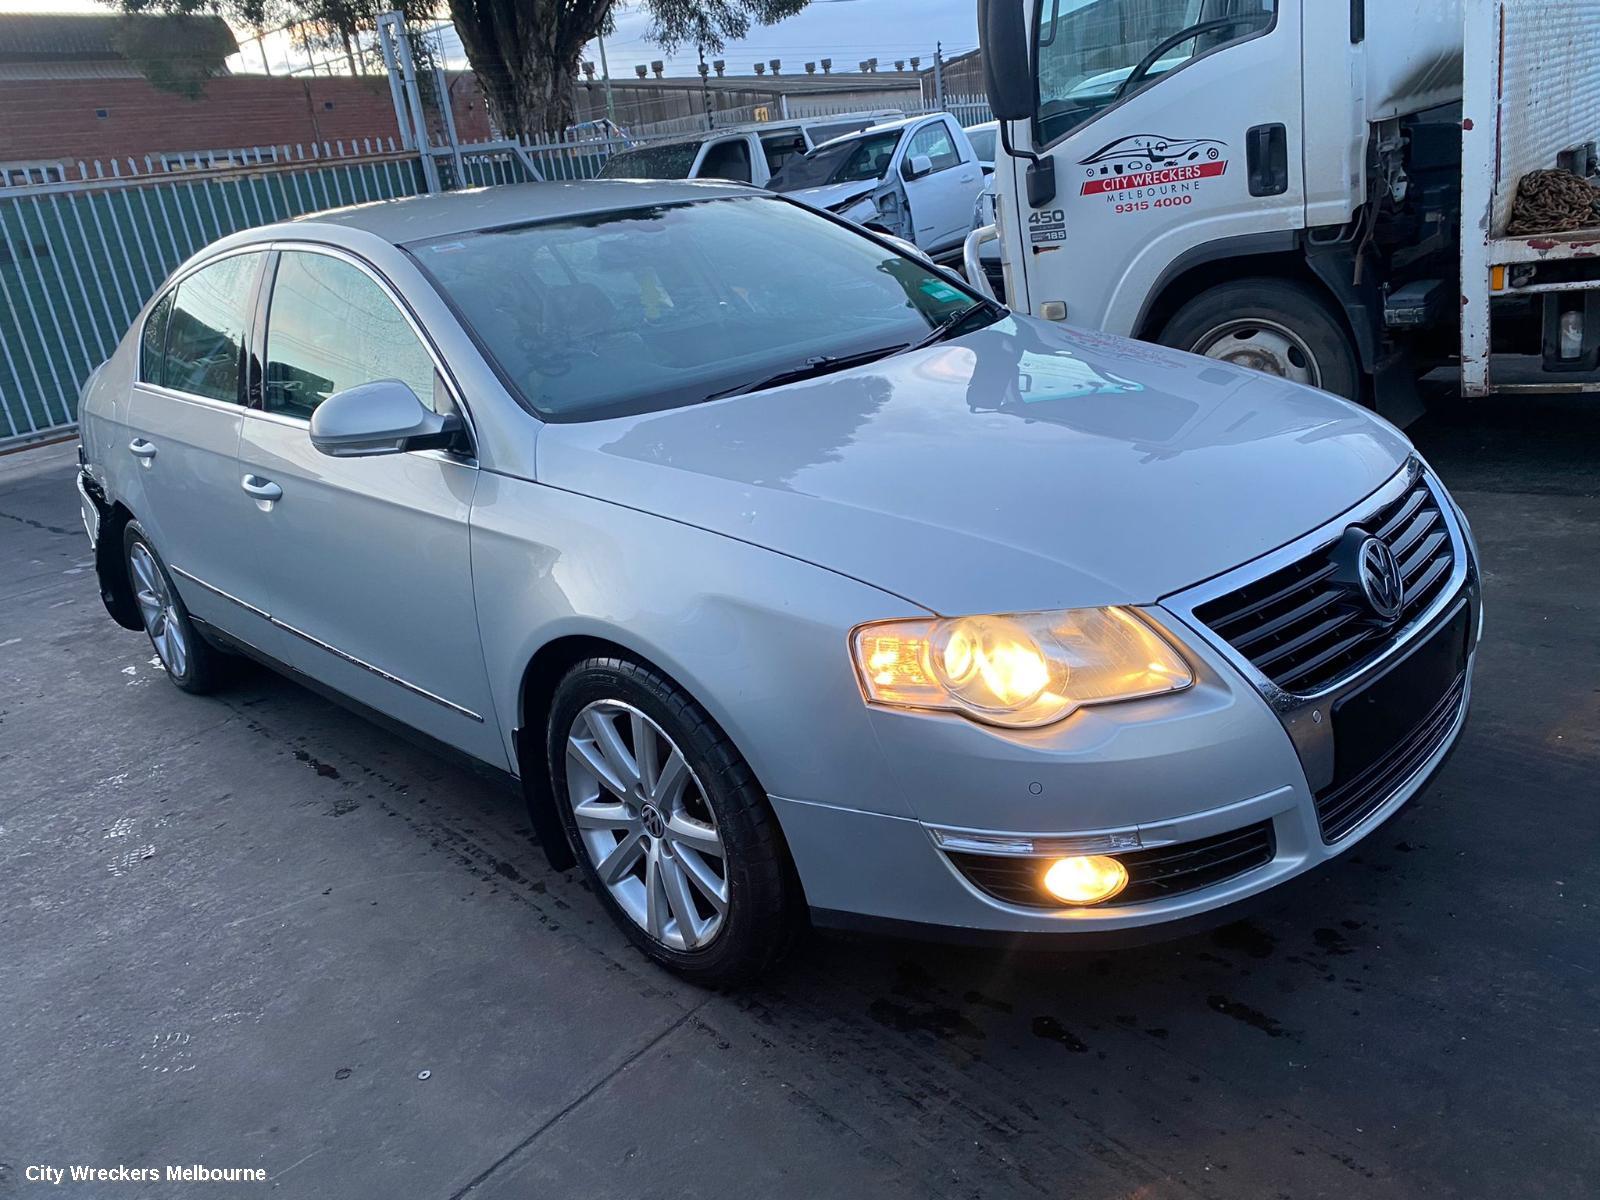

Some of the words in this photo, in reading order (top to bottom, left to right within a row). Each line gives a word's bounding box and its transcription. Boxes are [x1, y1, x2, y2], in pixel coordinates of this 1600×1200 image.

[1102, 176, 1128, 191] CITY
[1131, 165, 1201, 186] WRECKERS
[1106, 181, 1200, 202] MELBOURNE
[1115, 201, 1149, 213] 9315
[1153, 195, 1192, 208] 4000
[1028, 209, 1065, 224] 450
[1045, 231, 1065, 240] 185
